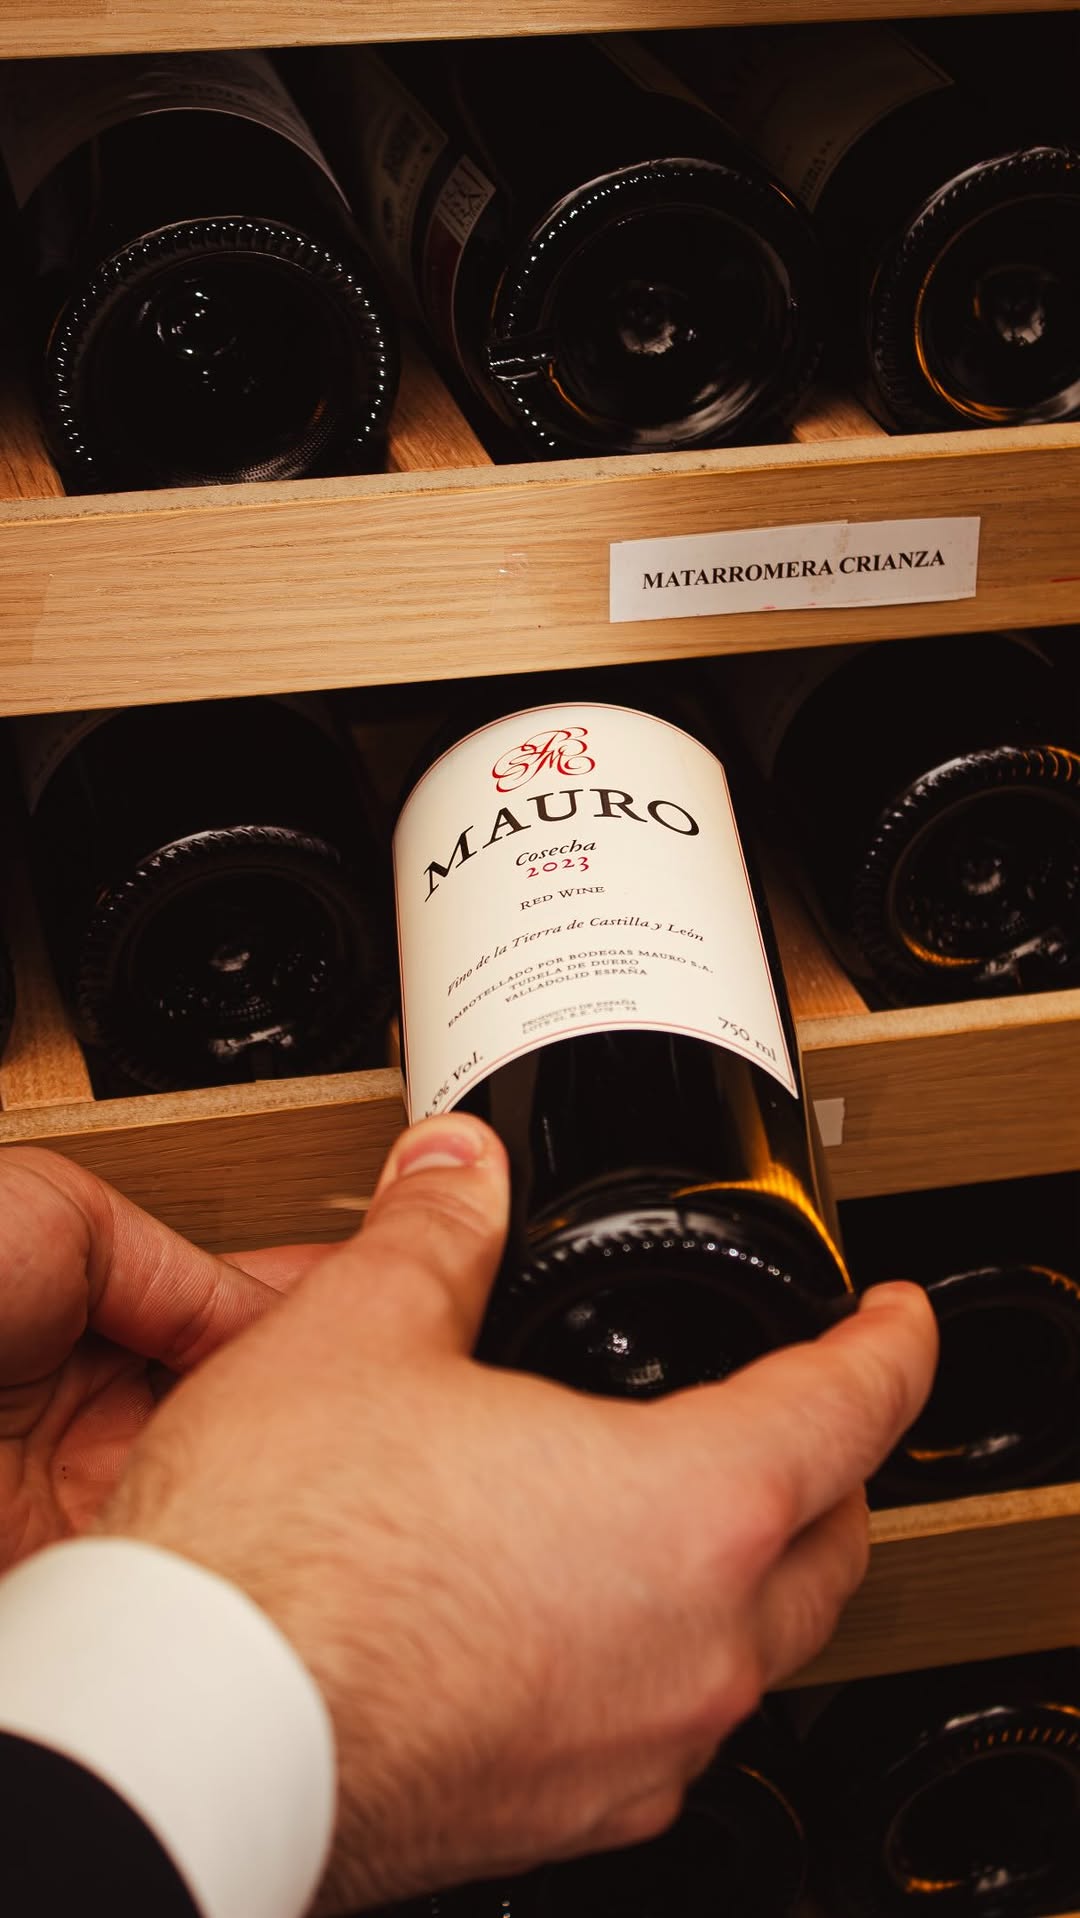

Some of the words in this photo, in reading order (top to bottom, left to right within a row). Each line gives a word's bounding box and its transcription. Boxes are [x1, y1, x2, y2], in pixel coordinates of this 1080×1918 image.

[642, 559, 832, 590] MATARROMERA
[839, 549, 946, 575] CRIANZA
[423, 788, 700, 902] MAURO
[515, 839, 597, 867] Cosecha
[526, 856, 590, 879] 2023
[519, 894, 553, 911] RED
[557, 886, 606, 898] WINE
[447, 966, 473, 996] Vino
[475, 955, 491, 970] de
[494, 945, 508, 959] la
[511, 925, 562, 949] Tierra
[566, 919, 585, 931] de
[589, 916, 650, 928] Castilla
[650, 922, 663, 931] y
[667, 923, 705, 942] León
[510, 967, 563, 991] TUDELA
[567, 961, 587, 971] DE
[591, 958, 640, 967] DUERO
[447, 966, 534, 1028] EMBOTELLADO
[538, 956, 565, 969] POR
[569, 949, 634, 961] BODEGAS
[638, 949, 687, 964] MAURO
[505, 971, 590, 1003] VALLADOLID
[594, 966, 648, 977] ESPAÑA
[717, 1016, 750, 1041] 750
[754, 1040, 777, 1062] ml
[453, 1051, 484, 1080] Vol.
